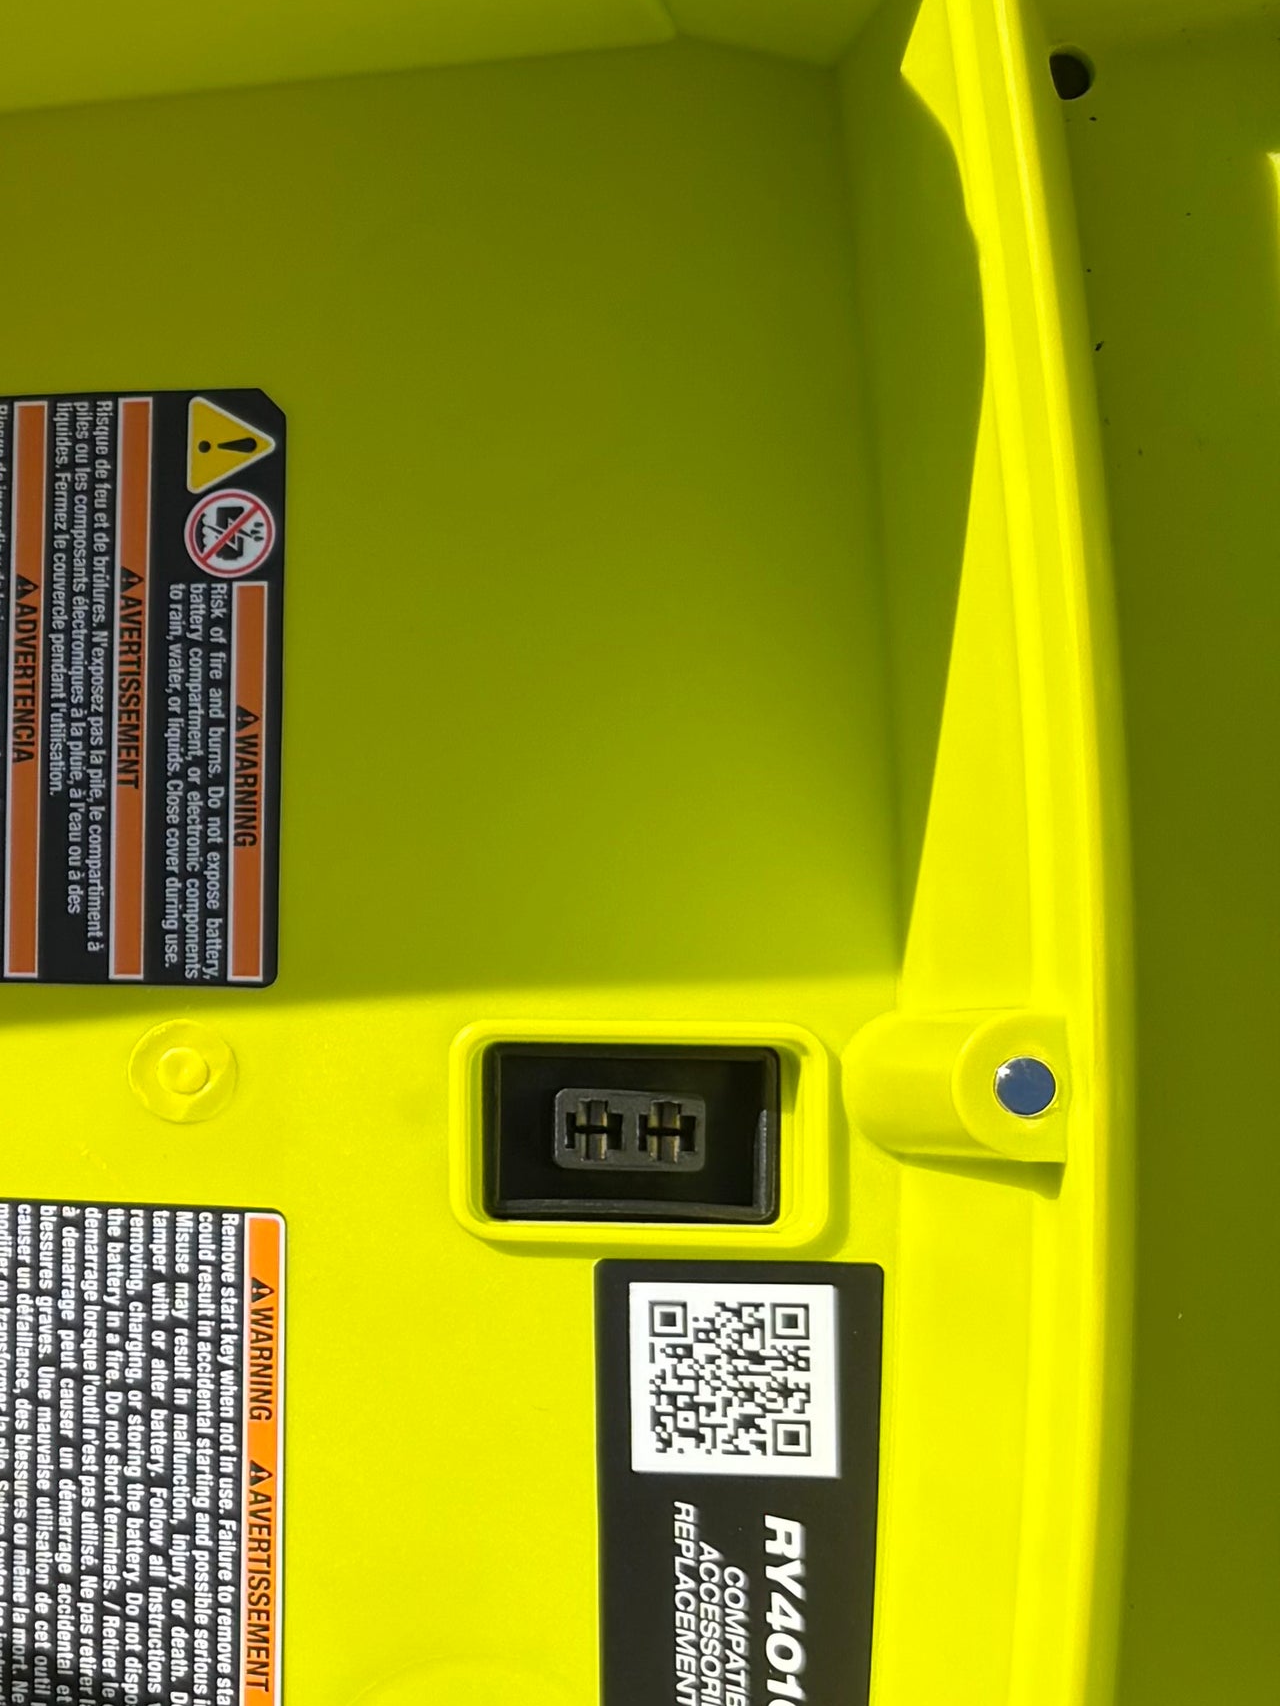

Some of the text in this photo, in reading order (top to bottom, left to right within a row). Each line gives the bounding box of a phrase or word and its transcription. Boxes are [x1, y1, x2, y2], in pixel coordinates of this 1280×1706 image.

[11, 600, 37, 763] ADVERTENCIA
[84, 400, 112, 951] Risque de feu et de brûlures. N'exposez pas la pile, le compartiment à
[115, 594, 142, 789] AVERTISSEMENT
[161, 583, 185, 967] to rain, water, or liquids. Close cover during use.
[181, 583, 206, 978] battery compartment, or electronic components
[201, 583, 227, 979] Risk of fire and burns. Do not expose battery,
[232, 733, 258, 848] WARNING
[125, 1208, 147, 1296] removing,
[148, 1209, 169, 1274] tamper
[174, 1210, 193, 1274] Misuse
[197, 1211, 216, 1261] could
[220, 1213, 239, 1283] Remove
[151, 1281, 169, 1322] with
[170, 1281, 189, 1320] may
[197, 1264, 215, 1317] result
[220, 1286, 238, 1331] start
[124, 1300, 146, 1385] charging,
[151, 1329, 165, 1350] or
[173, 1327, 192, 1380] result
[197, 1319, 215, 1337] in
[216, 1333, 238, 1366] key
[127, 1389, 142, 1410] or
[150, 1357, 169, 1401] alter
[173, 1387, 191, 1405] in
[196, 1340, 215, 1434] accidental
[219, 1369, 237, 1418] when
[123, 1413, 145, 1478] storing
[146, 1408, 168, 1478] battery.
[219, 1421, 236, 1452] not
[219, 1455, 237, 1474] in
[126, 1482, 144, 1512] the
[169, 1413, 191, 1526] malfunction,
[191, 1436, 214, 1509] starting
[218, 1476, 233, 1515] use.
[245, 1305, 273, 1693] WARNING AVERTISSEMENT
[148, 1486, 167, 1546] Follow
[194, 1511, 213, 1547] and
[122, 1516, 144, 1586] battery.
[148, 1554, 166, 1577] all
[167, 1533, 189, 1590] injury,
[217, 1518, 236, 1582] Failure
[125, 1591, 143, 1617] Do
[170, 1598, 185, 1619] or
[190, 1549, 212, 1626] possible
[217, 1584, 235, 1604] to
[124, 1621, 142, 1652] not
[147, 1585, 166, 1694] instructions
[170, 1625, 189, 1683] death.
[193, 1628, 211, 1696] serious
[216, 1607, 232, 1674] remove
